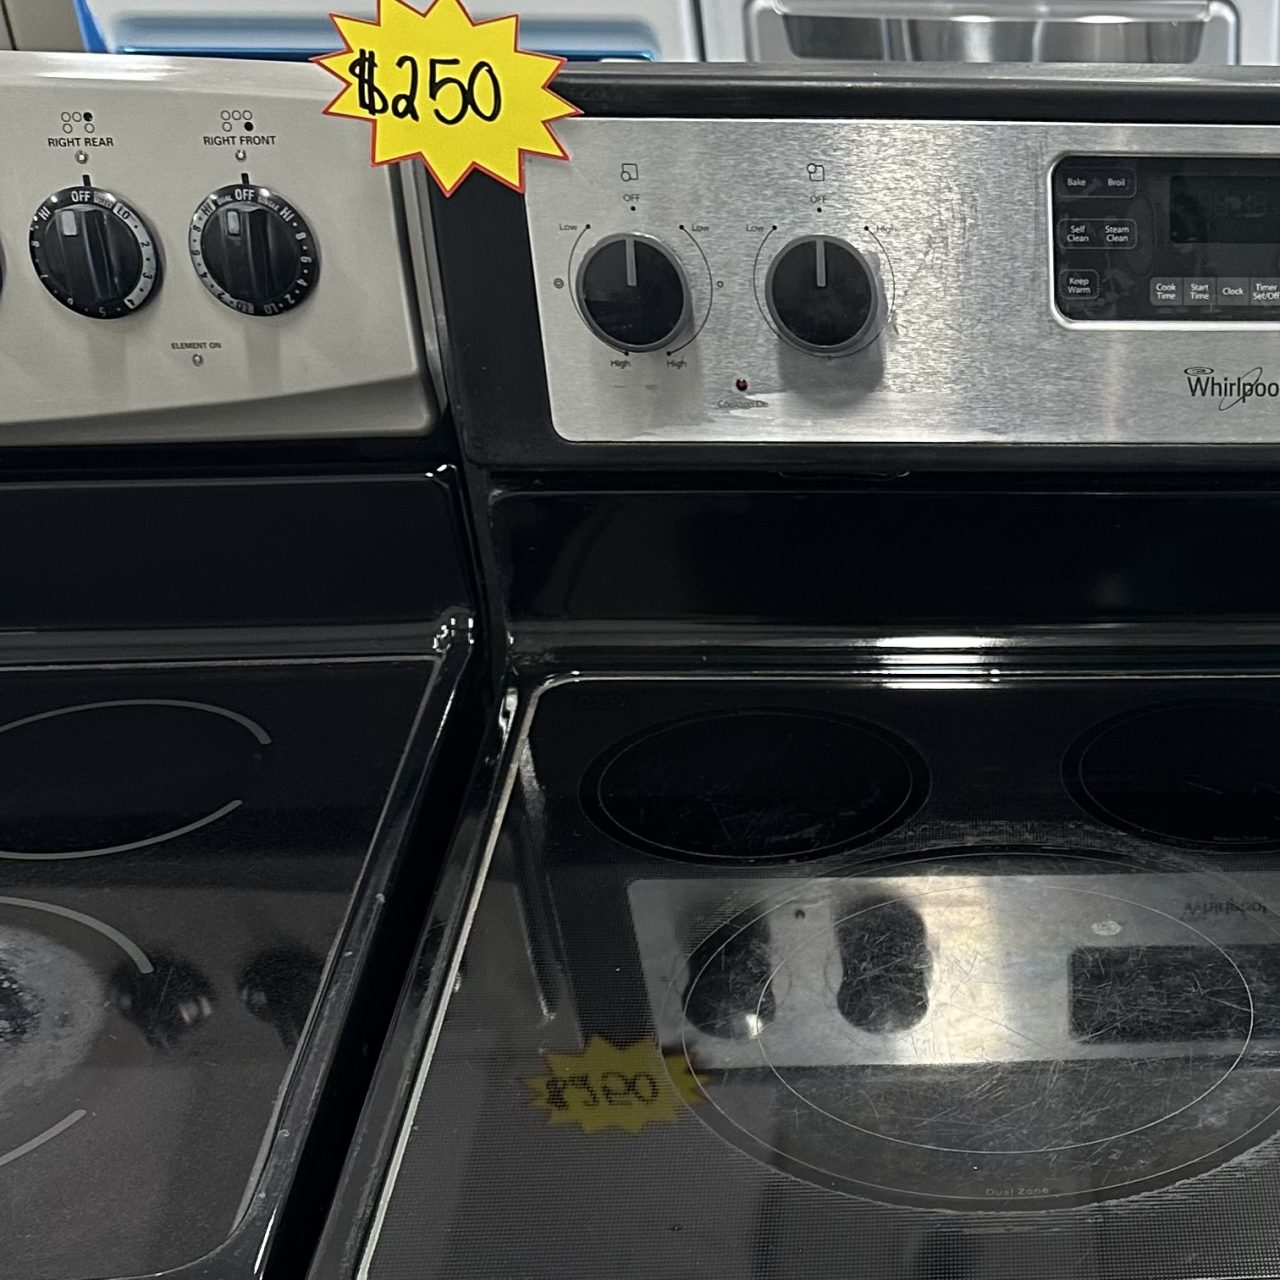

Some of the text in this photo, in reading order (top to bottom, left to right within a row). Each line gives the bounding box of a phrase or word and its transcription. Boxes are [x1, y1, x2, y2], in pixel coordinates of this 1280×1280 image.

[348, 48, 502, 126] $250
[47, 137, 114, 147] RIGHT REAR
[202, 135, 276, 146] RIGHT FRONT
[1066, 178, 1087, 187] Bake
[1107, 178, 1126, 187] Broil
[71, 190, 92, 203] OFF
[234, 188, 256, 201] OFF
[622, 193, 641, 203] OFF
[558, 223, 578, 232] Low
[691, 223, 710, 232] Low
[745, 223, 764, 233] Low
[1070, 224, 1086, 233] Self
[1104, 225, 1130, 233] Steam
[1066, 233, 1089, 242] Clean
[1106, 233, 1128, 242] Clean
[1068, 278, 1089, 287] Keep
[1155, 282, 1177, 292] Cook
[1190, 282, 1209, 292] Start
[1255, 282, 1278, 292] Timer
[1067, 286, 1091, 294] Warm
[1222, 286, 1244, 296] Clock
[1156, 291, 1176, 300] Time
[1190, 291, 1210, 300] Time
[1252, 291, 1280, 301] Set/Off
[610, 360, 631, 370] High
[666, 360, 687, 370] High
[985, 1187, 1050, 1197] Dual Zone
